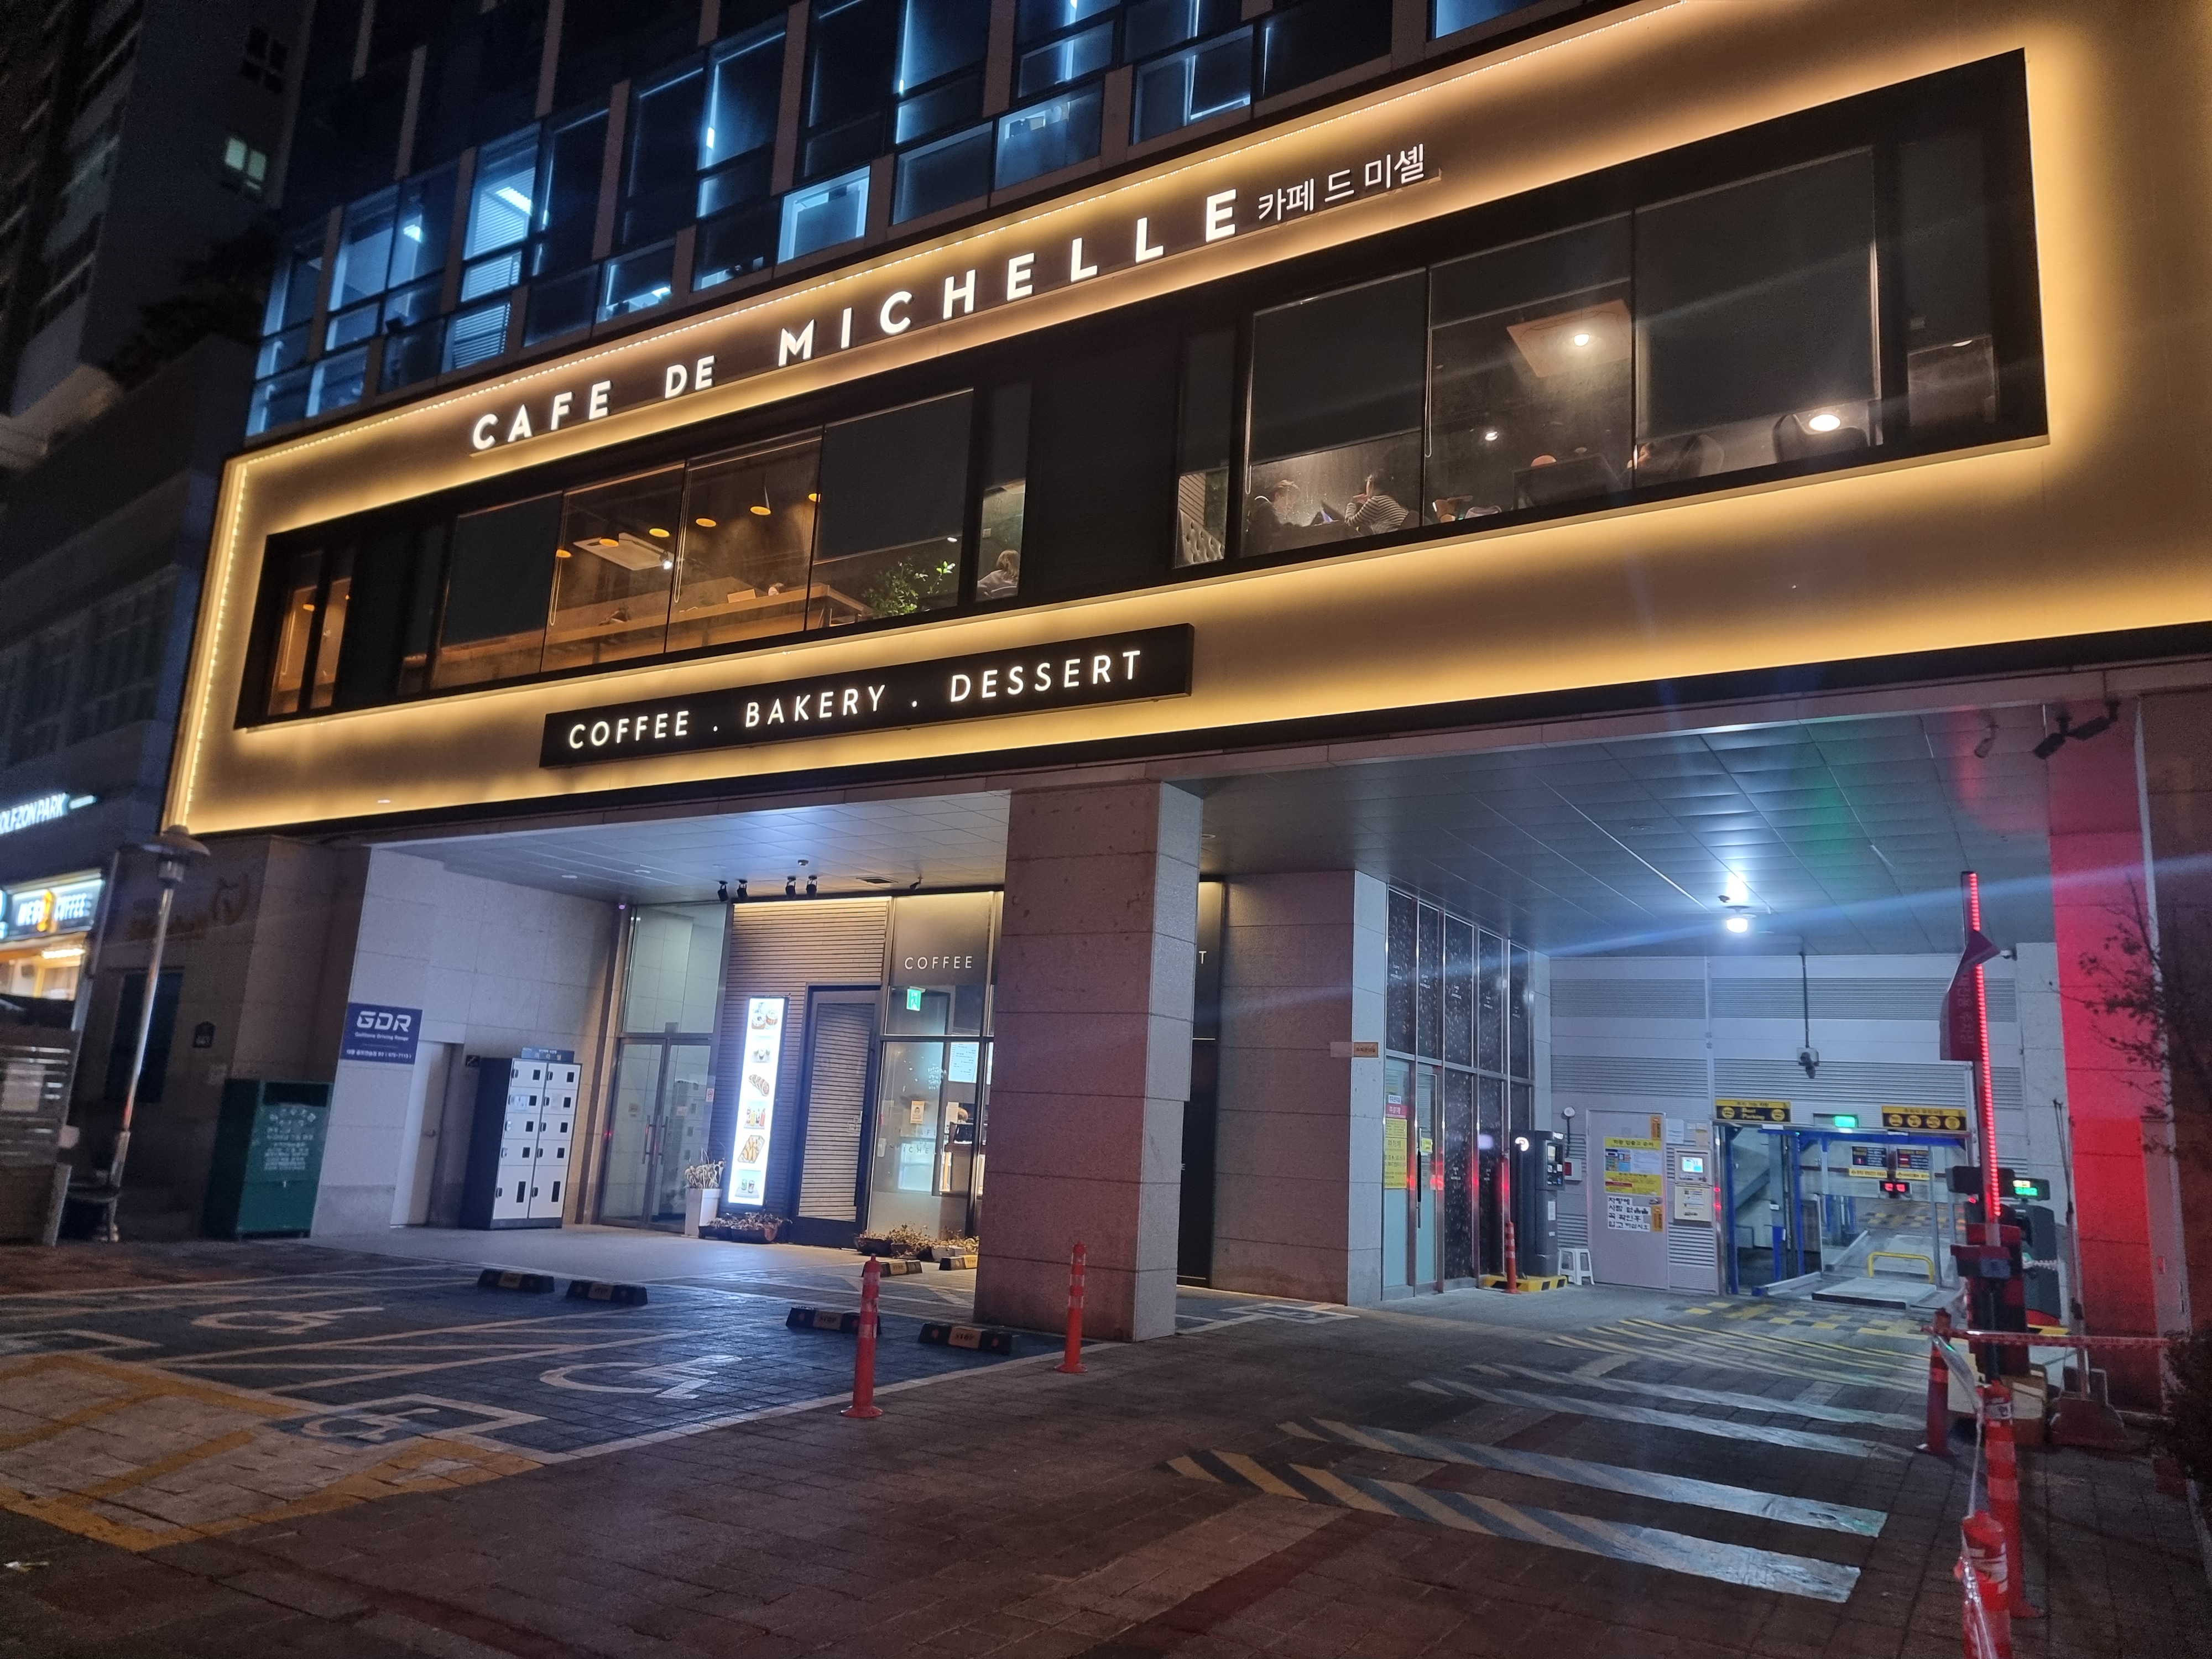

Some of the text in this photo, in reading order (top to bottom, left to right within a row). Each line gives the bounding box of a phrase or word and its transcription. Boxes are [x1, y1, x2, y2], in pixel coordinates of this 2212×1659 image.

[1258, 143, 1425, 221] 카페 드 미셸
[472, 188, 1238, 450] CAFE DE MICHELLE
[569, 710, 690, 749] COFFEE
[745, 685, 885, 728] BAKERY
[950, 650, 1141, 703] DESSERT
[37, 792, 69, 823] PARK
[904, 956, 973, 970] COFFEE
[357, 1010, 411, 1032] GDR
